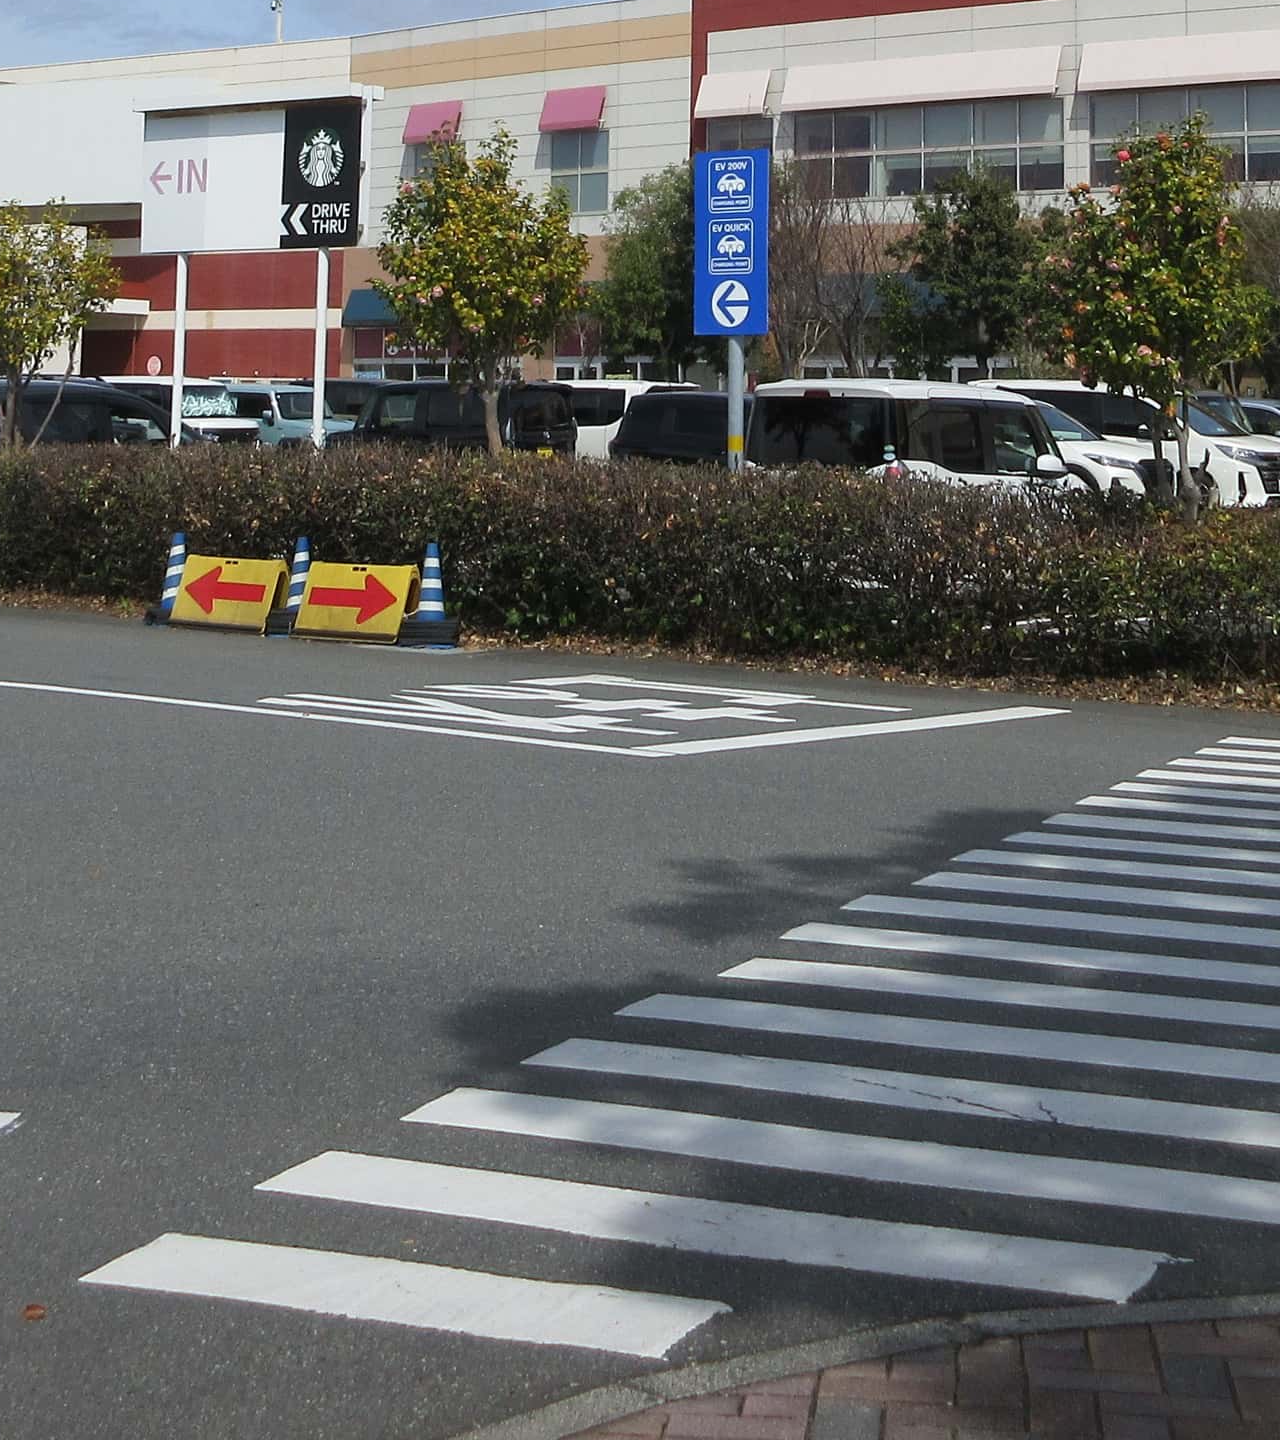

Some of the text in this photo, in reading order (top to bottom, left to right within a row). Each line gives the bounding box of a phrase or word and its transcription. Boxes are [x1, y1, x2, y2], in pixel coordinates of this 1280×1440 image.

[715, 161, 747, 171] EV 200V
[177, 159, 208, 194] IN
[312, 203, 351, 218] DRIVE
[312, 219, 347, 234] THRU
[712, 223, 750, 232] EV QUICK
